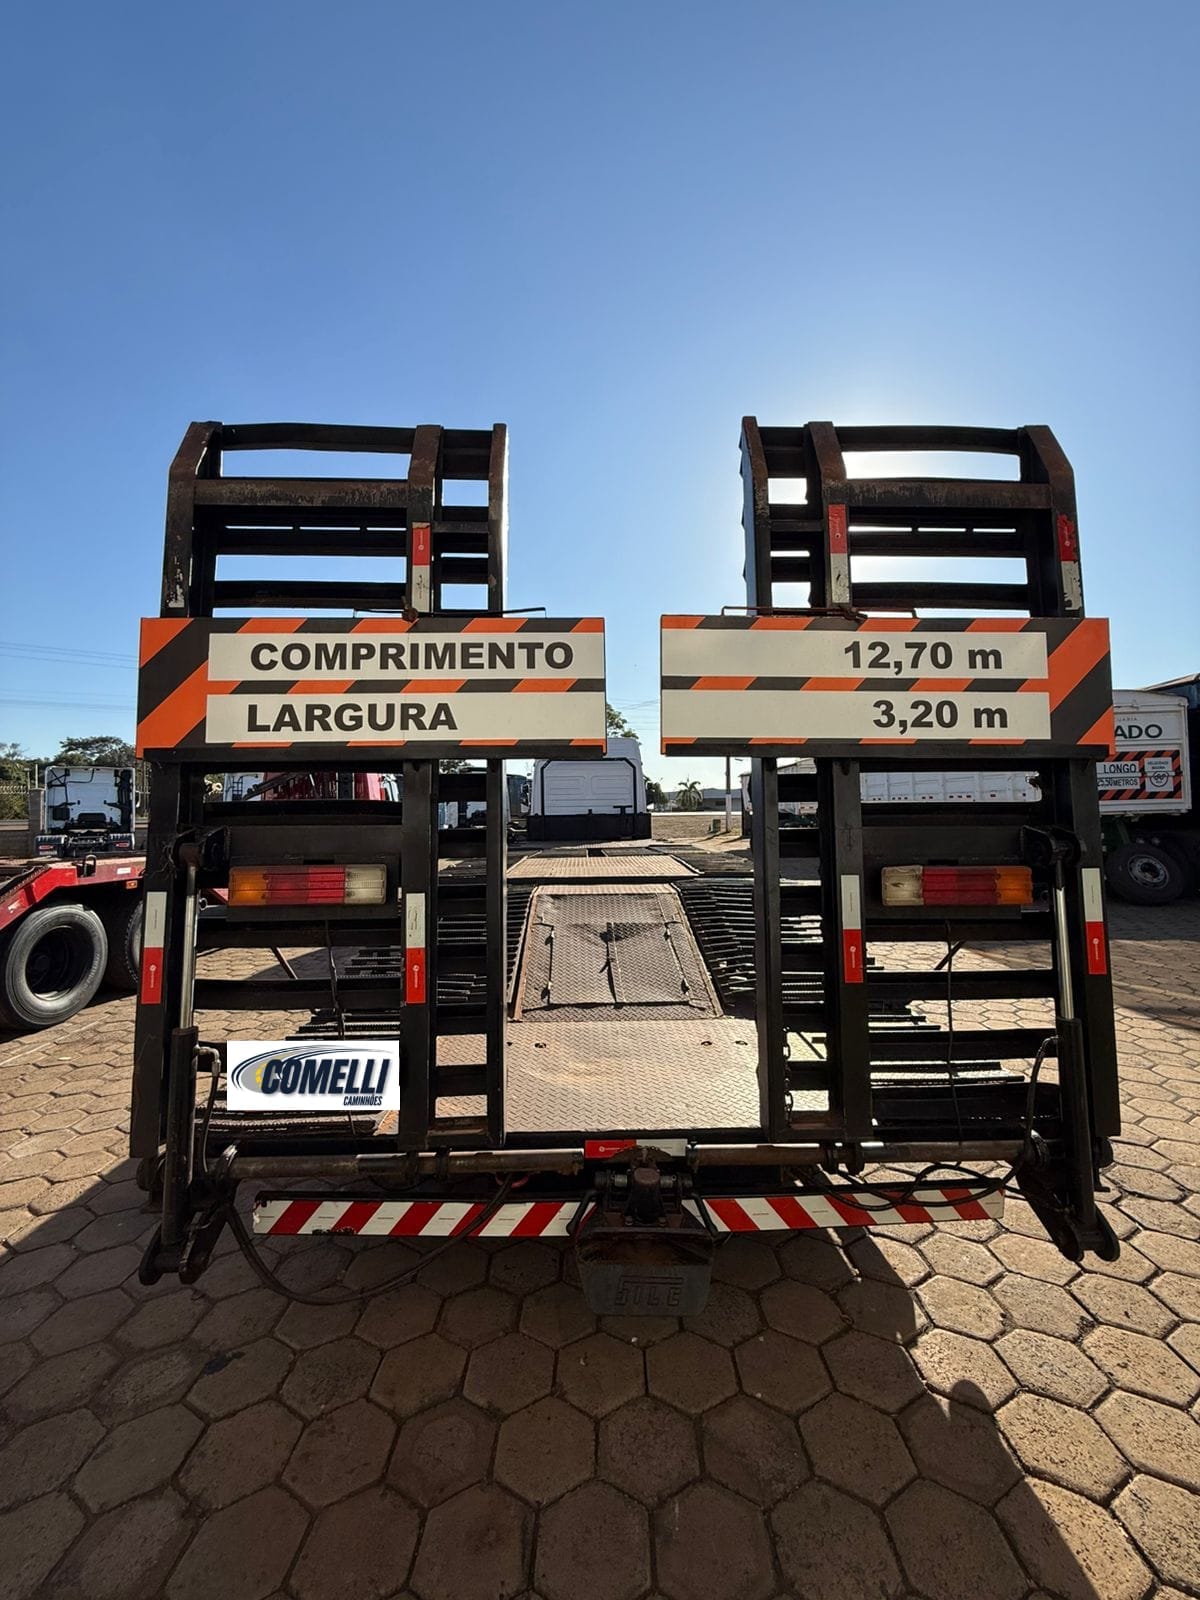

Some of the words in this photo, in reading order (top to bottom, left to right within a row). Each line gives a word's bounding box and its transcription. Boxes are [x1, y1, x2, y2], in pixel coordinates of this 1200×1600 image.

[250, 642, 573, 670] COMPRIMENTO
[845, 641, 952, 675] 12,70
[969, 648, 1002, 669] m
[247, 702, 458, 732] LARGURA
[873, 700, 958, 735] 3,20
[974, 707, 1007, 728] m
[1103, 763, 1137, 774] LONGO
